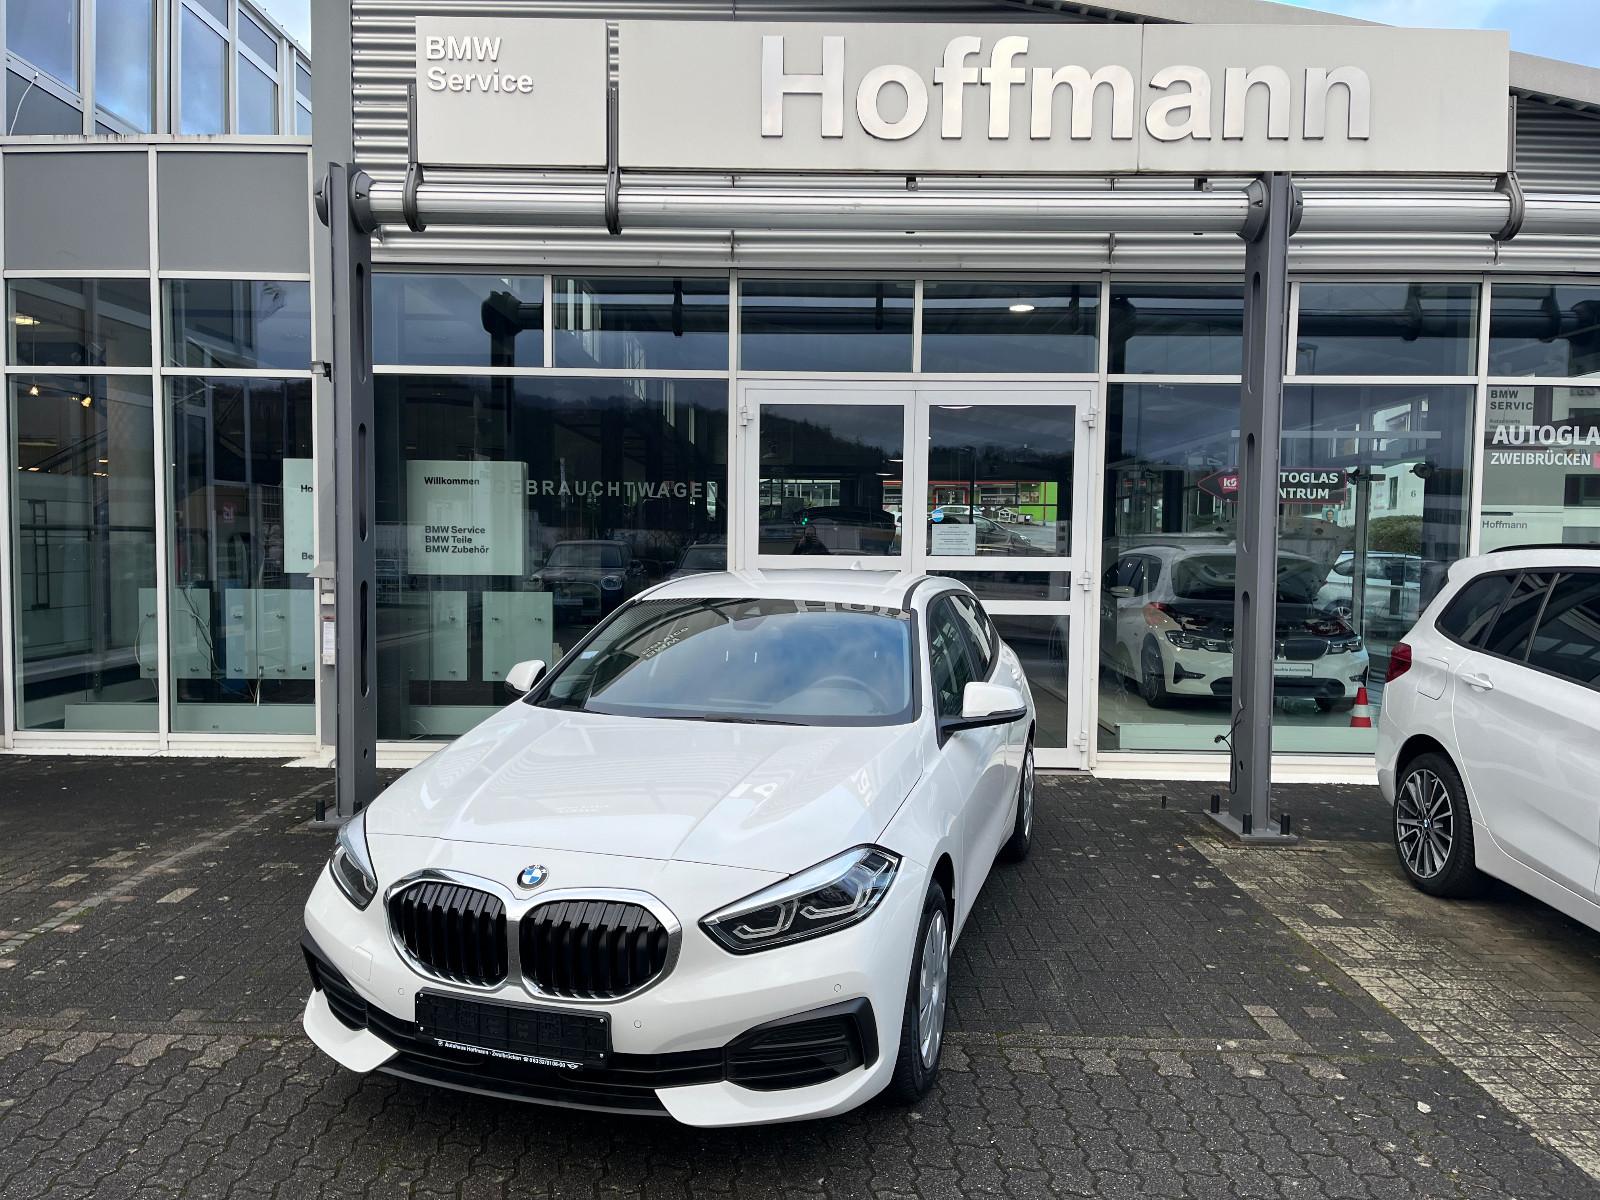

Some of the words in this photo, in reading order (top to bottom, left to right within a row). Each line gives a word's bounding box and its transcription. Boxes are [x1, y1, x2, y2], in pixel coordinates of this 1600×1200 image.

[426, 36, 501, 62] BMW
[427, 66, 534, 93] Service
[760, 35, 1372, 143] Hoffmann
[1490, 390, 1519, 399] BMW
[1490, 401, 1534, 411] SERVIC
[1491, 425, 1600, 446] AUTOGLA
[1490, 450, 1591, 466] ZWEIBRÜCKEN
[424, 476, 480, 486] Willkommen
[1279, 472, 1339, 484] TOGLAS
[300, 484, 314, 493] Ho
[493, 480, 718, 498] GEBRAUCHTWAGEN
[1279, 487, 1329, 499] NTRUM
[425, 525, 449, 534] BMW
[451, 525, 486, 534] Service
[1482, 520, 1528, 529] Hoffmann
[425, 535, 449, 544] BMW
[451, 535, 473, 544] Teile
[425, 545, 449, 553] BMW
[451, 545, 489, 554] Zubehör
[301, 552, 314, 560] Be
